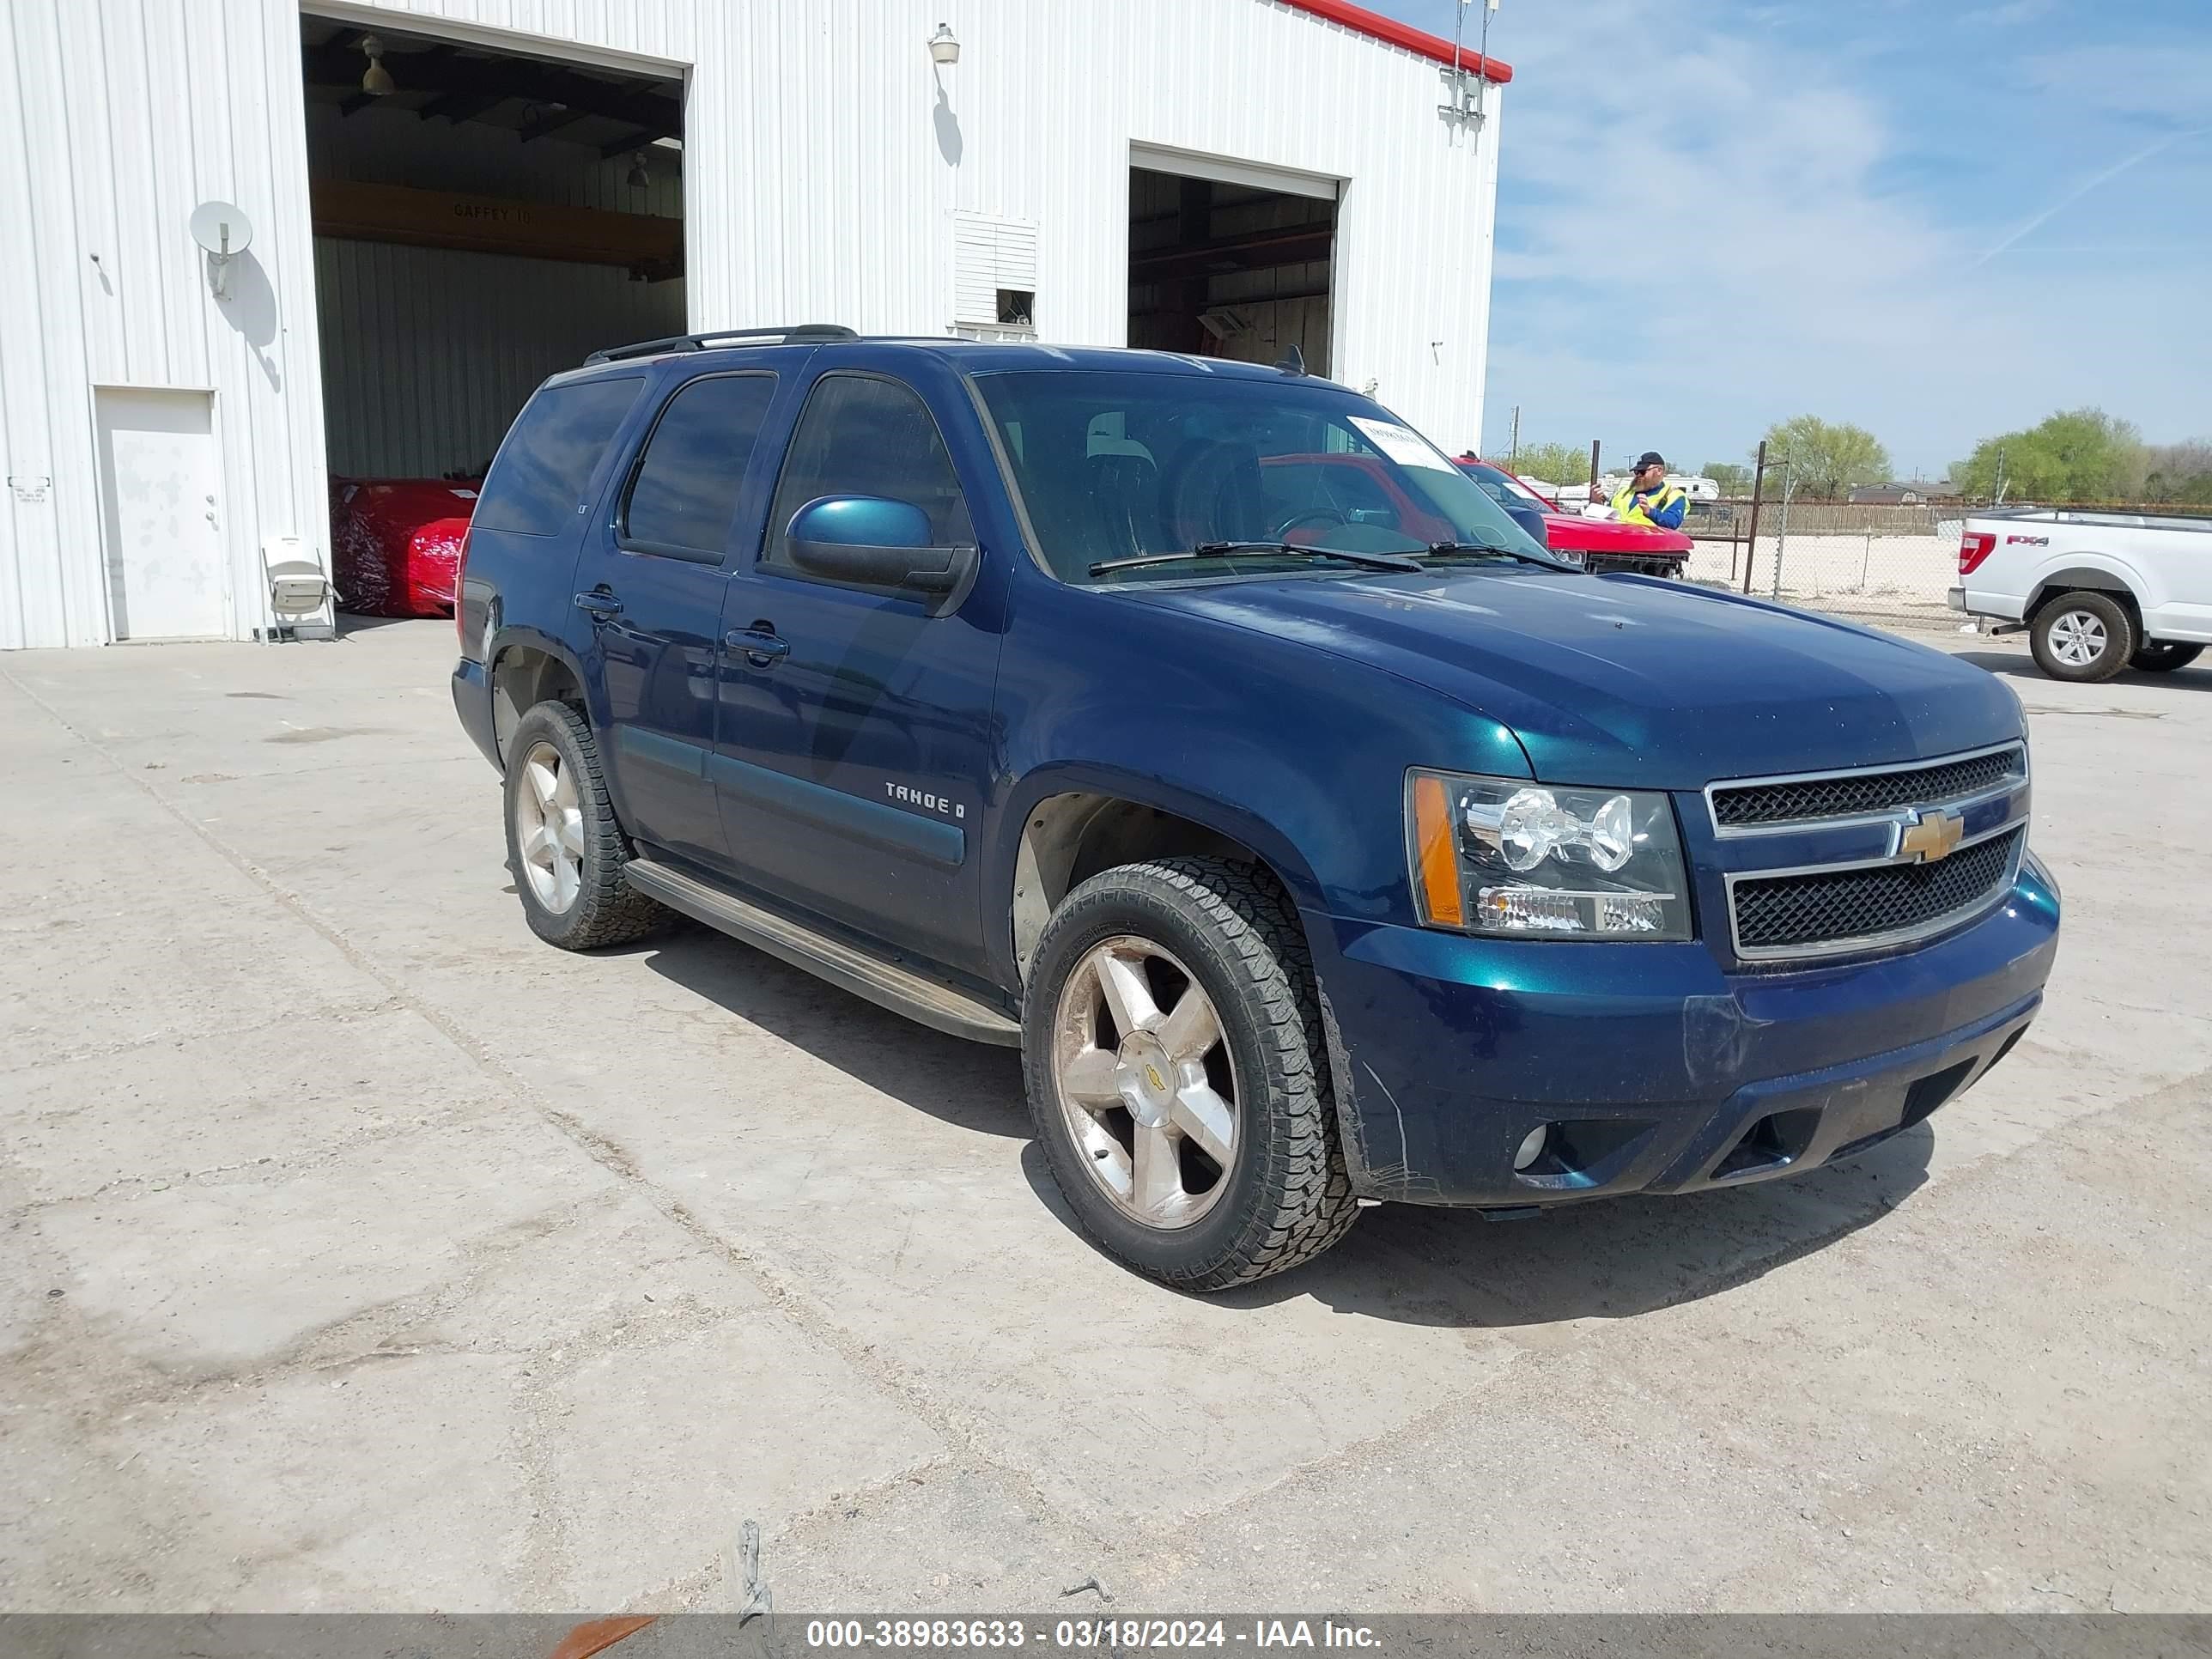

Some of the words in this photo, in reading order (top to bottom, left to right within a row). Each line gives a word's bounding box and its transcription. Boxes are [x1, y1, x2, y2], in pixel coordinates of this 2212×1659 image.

[454, 204, 508, 220] GAFFEY
[578, 504, 588, 514] LT
[2006, 535, 2049, 547] FX4
[885, 781, 949, 814] TAHOE
